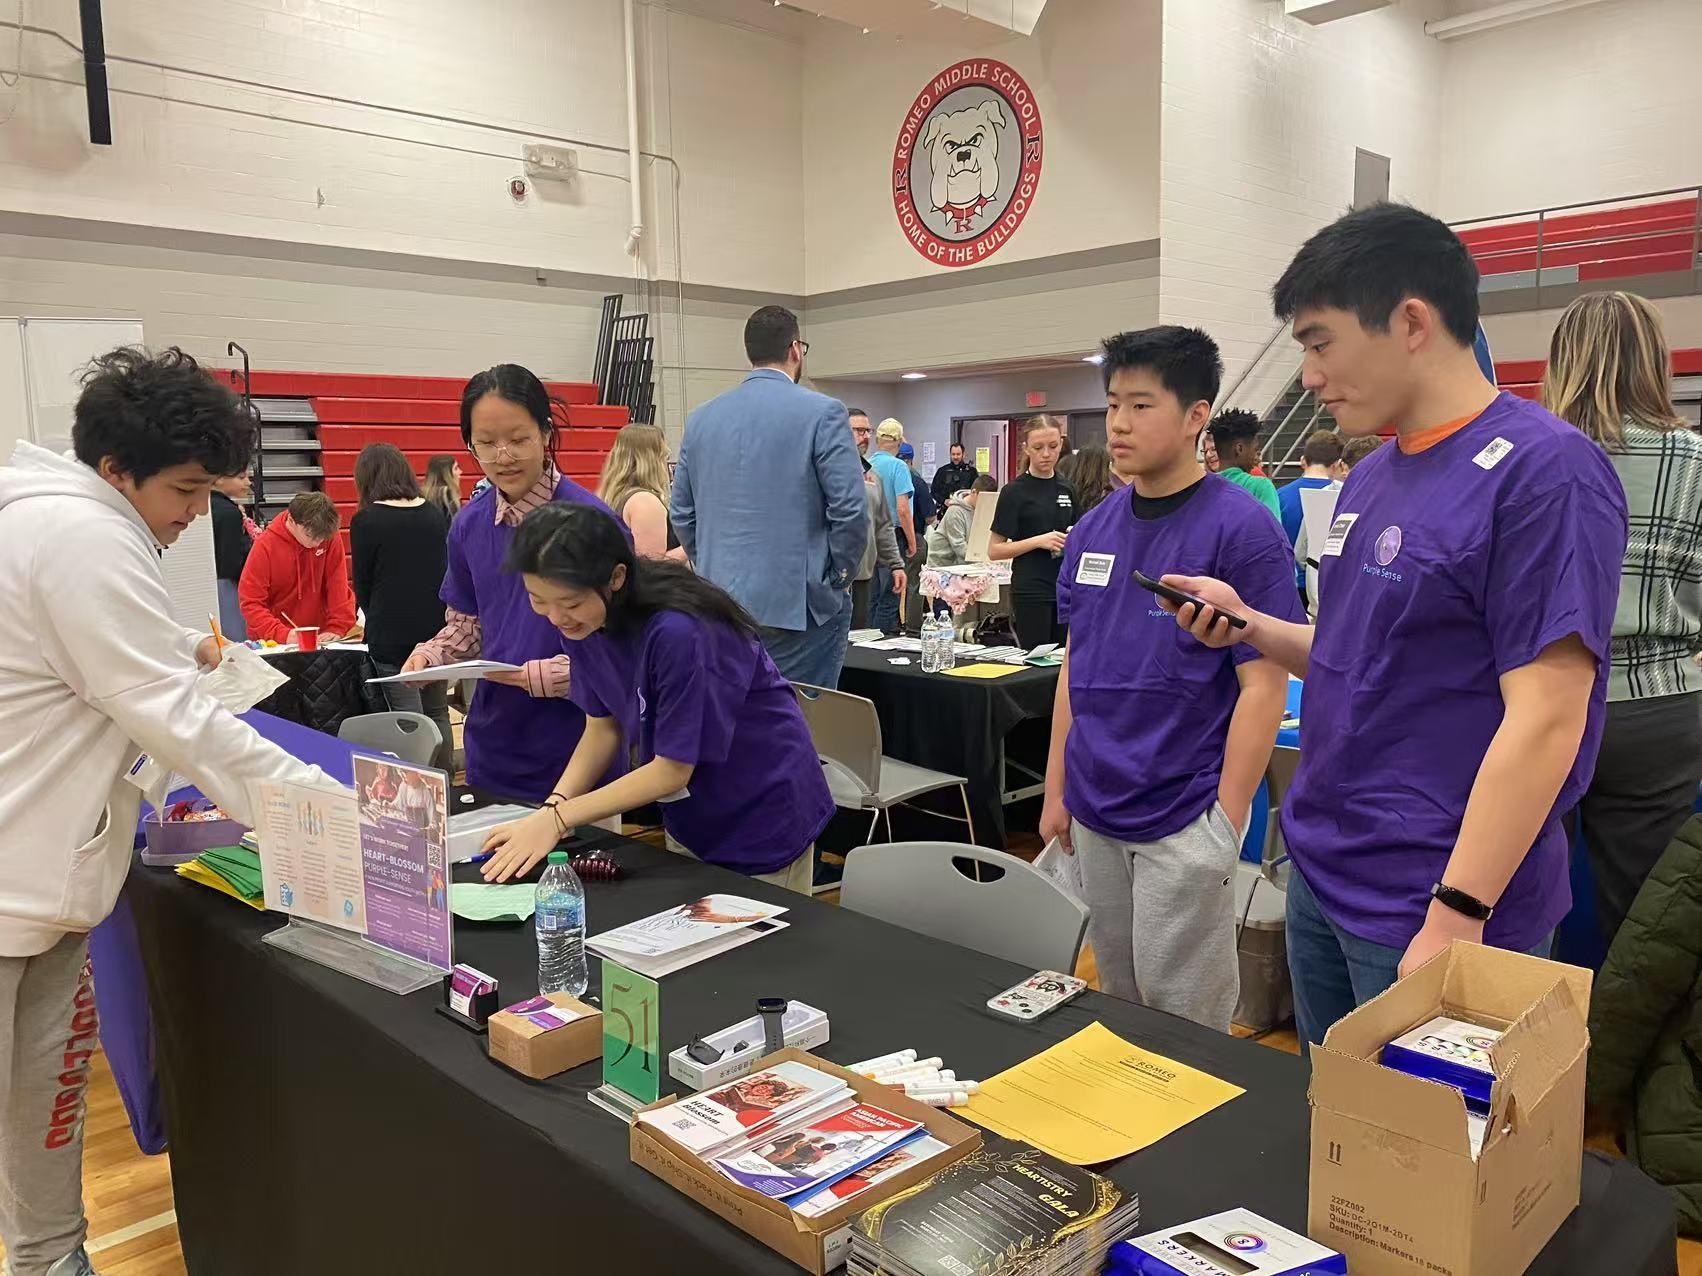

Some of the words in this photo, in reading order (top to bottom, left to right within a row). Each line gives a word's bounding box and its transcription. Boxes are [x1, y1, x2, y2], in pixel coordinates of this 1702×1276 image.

[898, 94, 931, 158] ROMEO
[934, 64, 988, 95] MIDDLE
[991, 67, 1036, 130] SCHOOL
[899, 200, 927, 248] HOME
[927, 241, 945, 259] OF
[949, 248, 974, 262] THE
[978, 172, 1036, 256] BULLDOGS
[1362, 563, 1380, 576] Purple
[363, 848, 424, 874] HEART-BLOSSOM
[364, 861, 411, 884] PURPLE-SENSE
[610, 983, 652, 1074] 51
[1136, 1061, 1177, 1079] ROMEO
[682, 1104, 720, 1124] Blossom
[690, 1101, 724, 1116] HEART
[850, 1111, 887, 1128] AMERICAN
[855, 1109, 878, 1119] ASIAN
[876, 1116, 905, 1129] PACIFIC
[1012, 1163, 1073, 1198] HEARTISTRY
[1038, 1194, 1080, 1218] GALA
[1329, 1204, 1350, 1218] SKU:
[1329, 1213, 1366, 1233] Quantity:
[1368, 1228, 1373, 1236] 1
[1329, 1222, 1379, 1247] Description:
[1380, 1241, 1413, 1261] Markers
